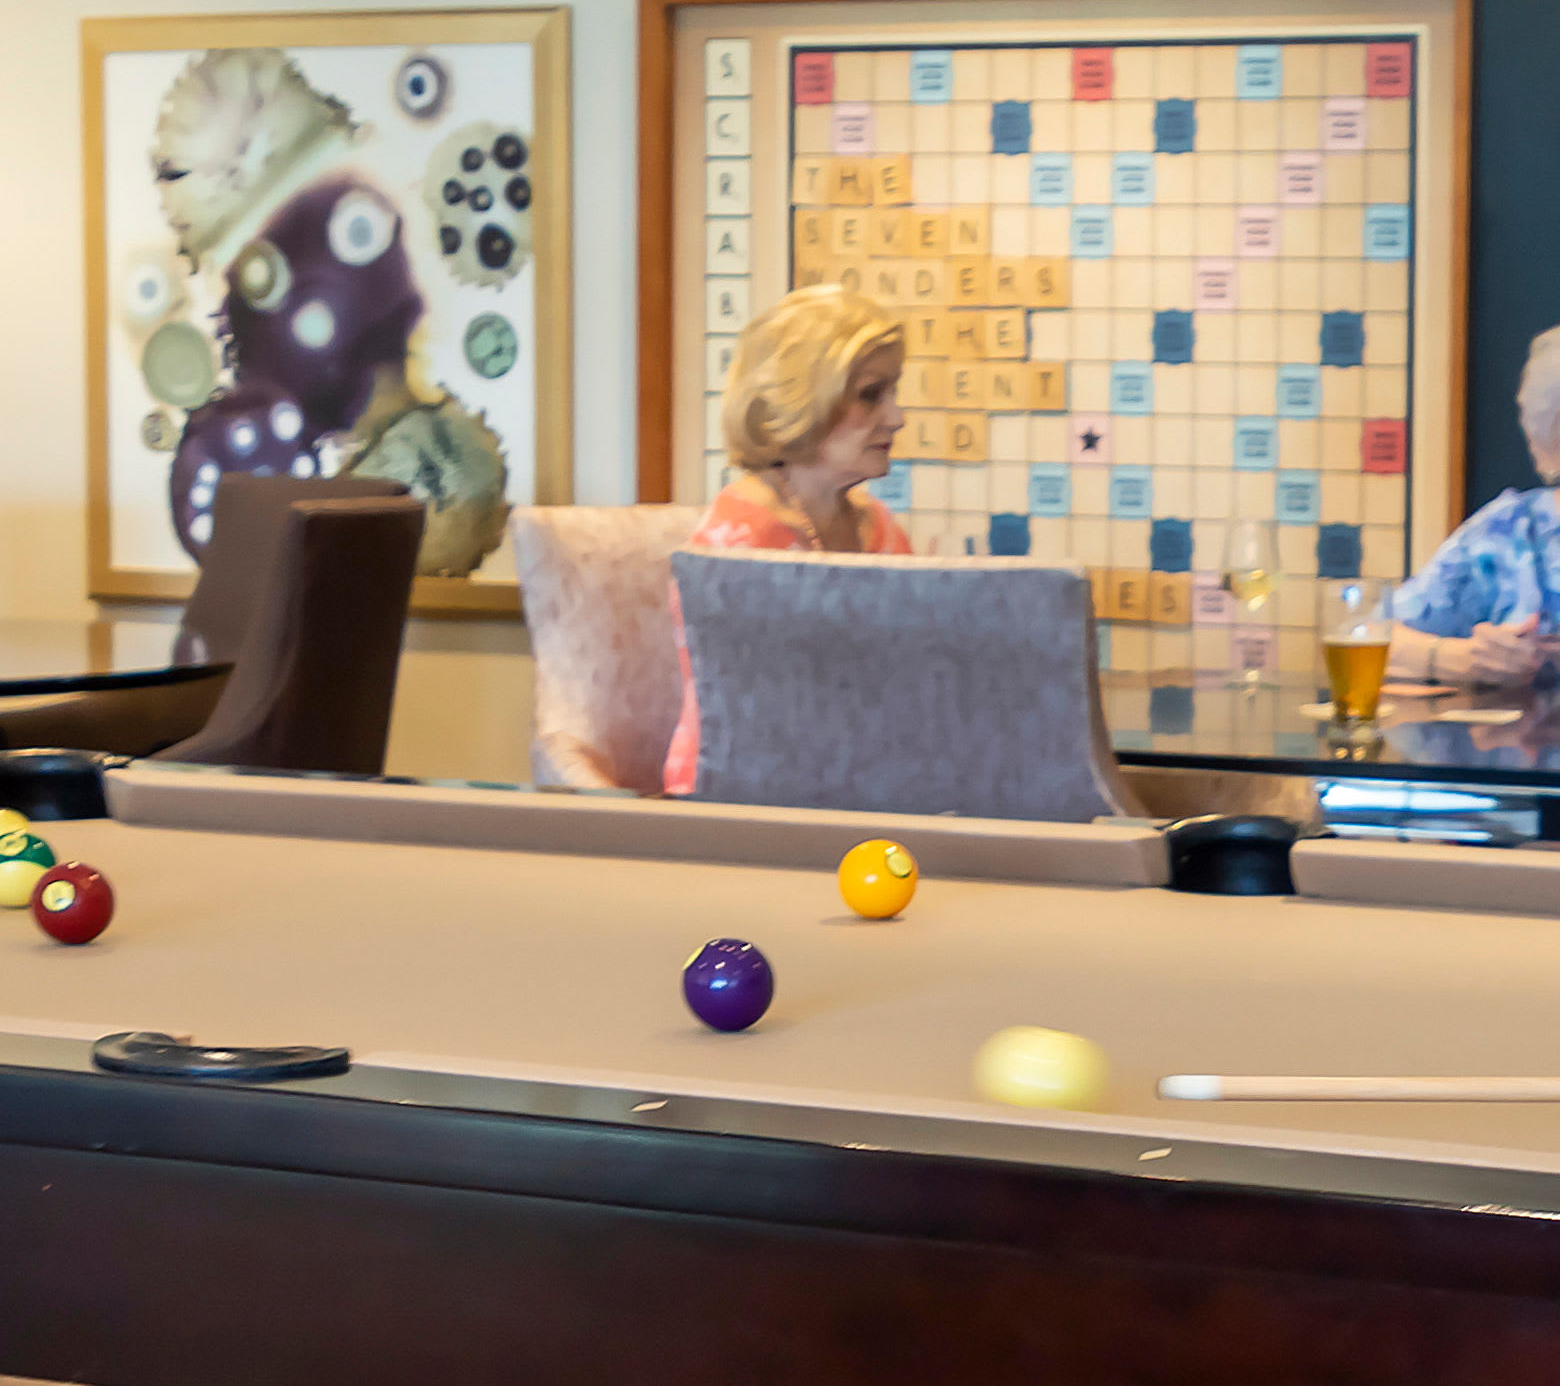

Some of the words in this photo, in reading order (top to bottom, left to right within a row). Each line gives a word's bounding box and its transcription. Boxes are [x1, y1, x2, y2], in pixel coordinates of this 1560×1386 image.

[805, 164, 897, 193] THE
[804, 216, 979, 247] SEVEN
[920, 318, 1013, 348] THE
